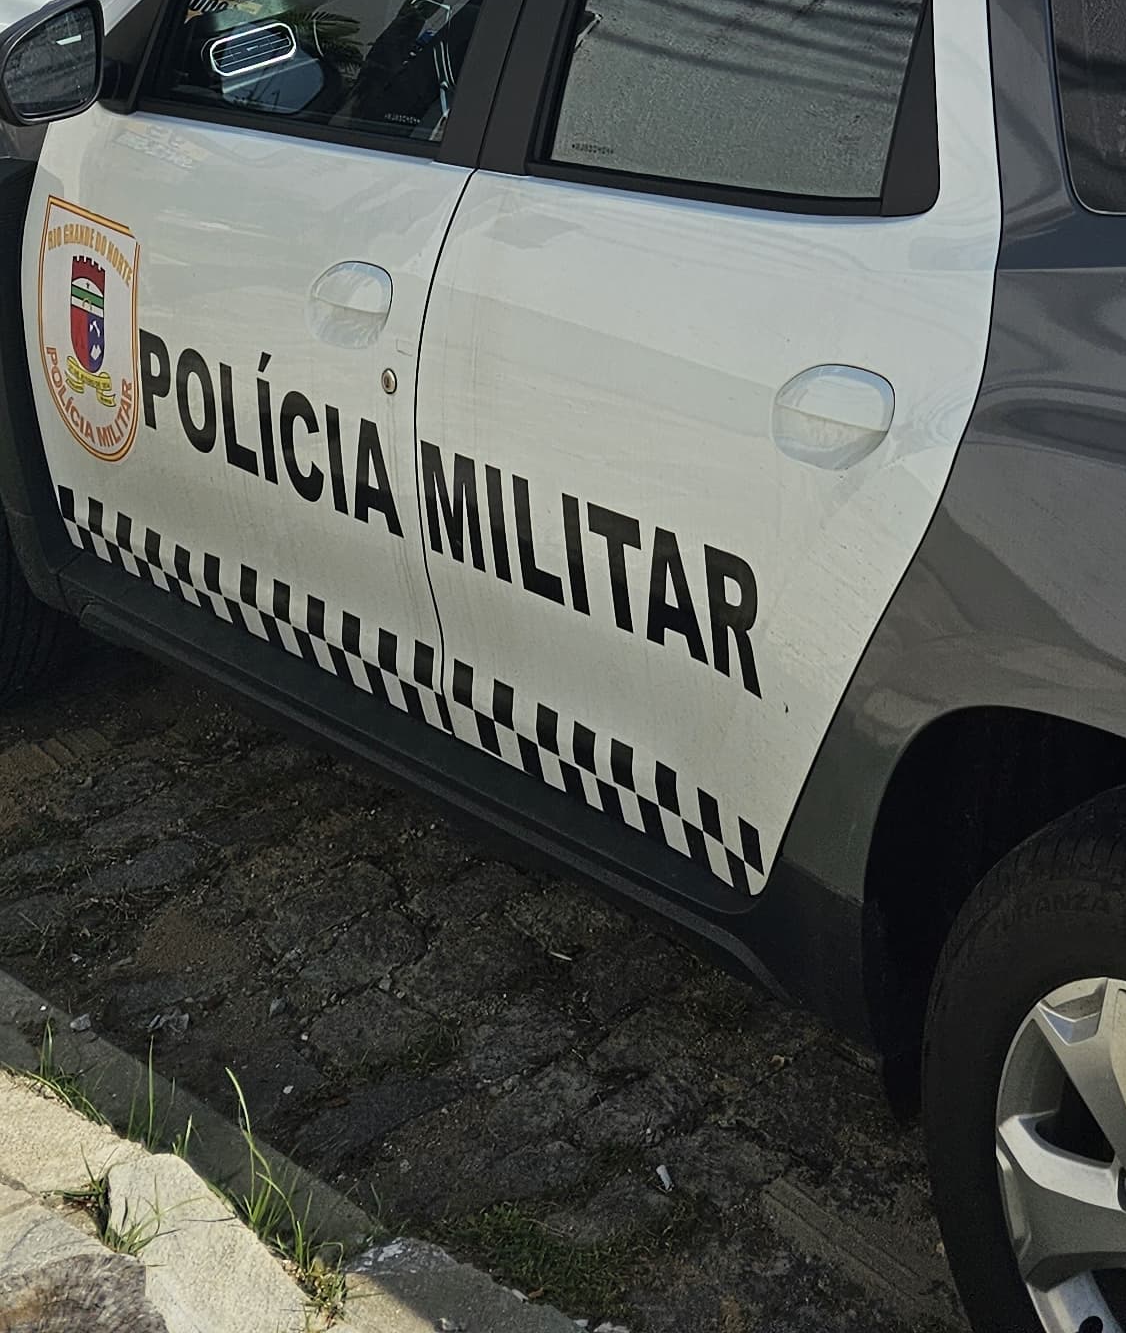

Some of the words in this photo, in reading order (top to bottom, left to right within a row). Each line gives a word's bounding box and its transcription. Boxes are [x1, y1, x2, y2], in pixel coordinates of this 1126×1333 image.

[48, 226, 62, 251] RIO
[63, 223, 95, 249] GRANDE
[94, 231, 107, 257] DO
[106, 241, 132, 288] NORTE
[46, 346, 96, 445] POLÍCIA
[96, 378, 132, 448] MILITAR
[139, 328, 404, 539] POLÍCIA
[420, 439, 762, 700] MILITAR
